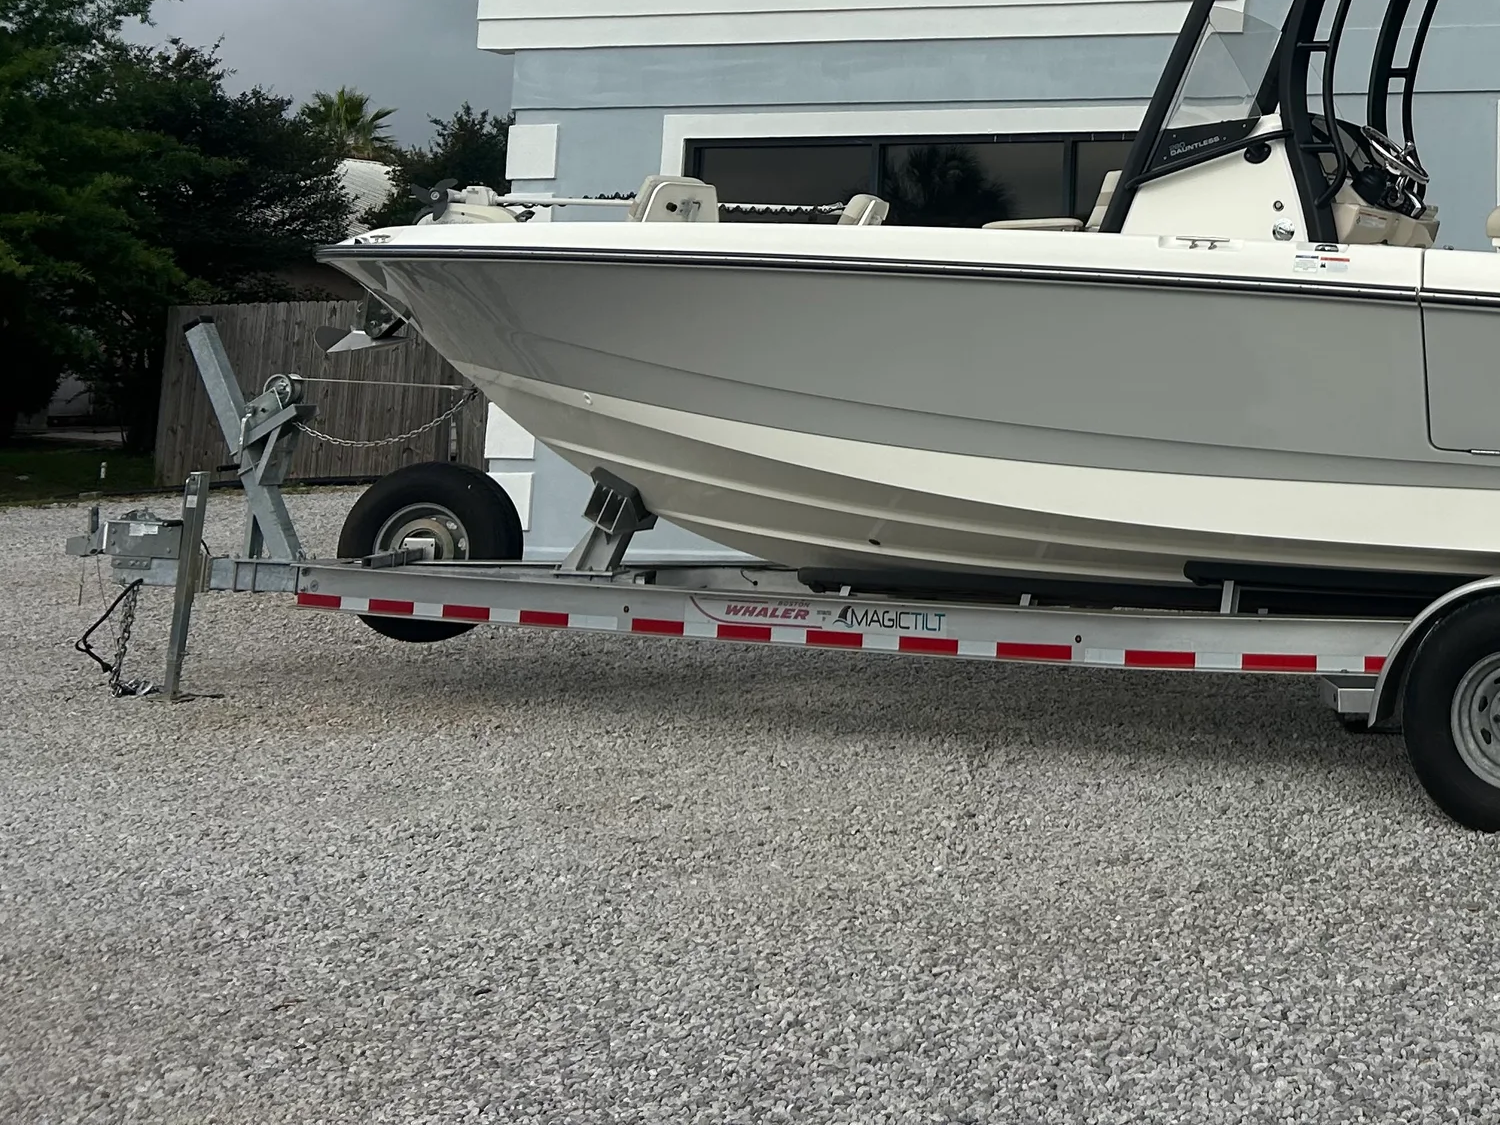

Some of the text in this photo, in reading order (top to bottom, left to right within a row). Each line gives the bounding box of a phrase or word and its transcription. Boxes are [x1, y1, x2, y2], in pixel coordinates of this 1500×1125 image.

[1170, 135, 1220, 156] DAUNTLESS
[725, 604, 810, 621] WHALER
[777, 600, 811, 608] BOSTON
[850, 607, 946, 632] MAGICTILT
